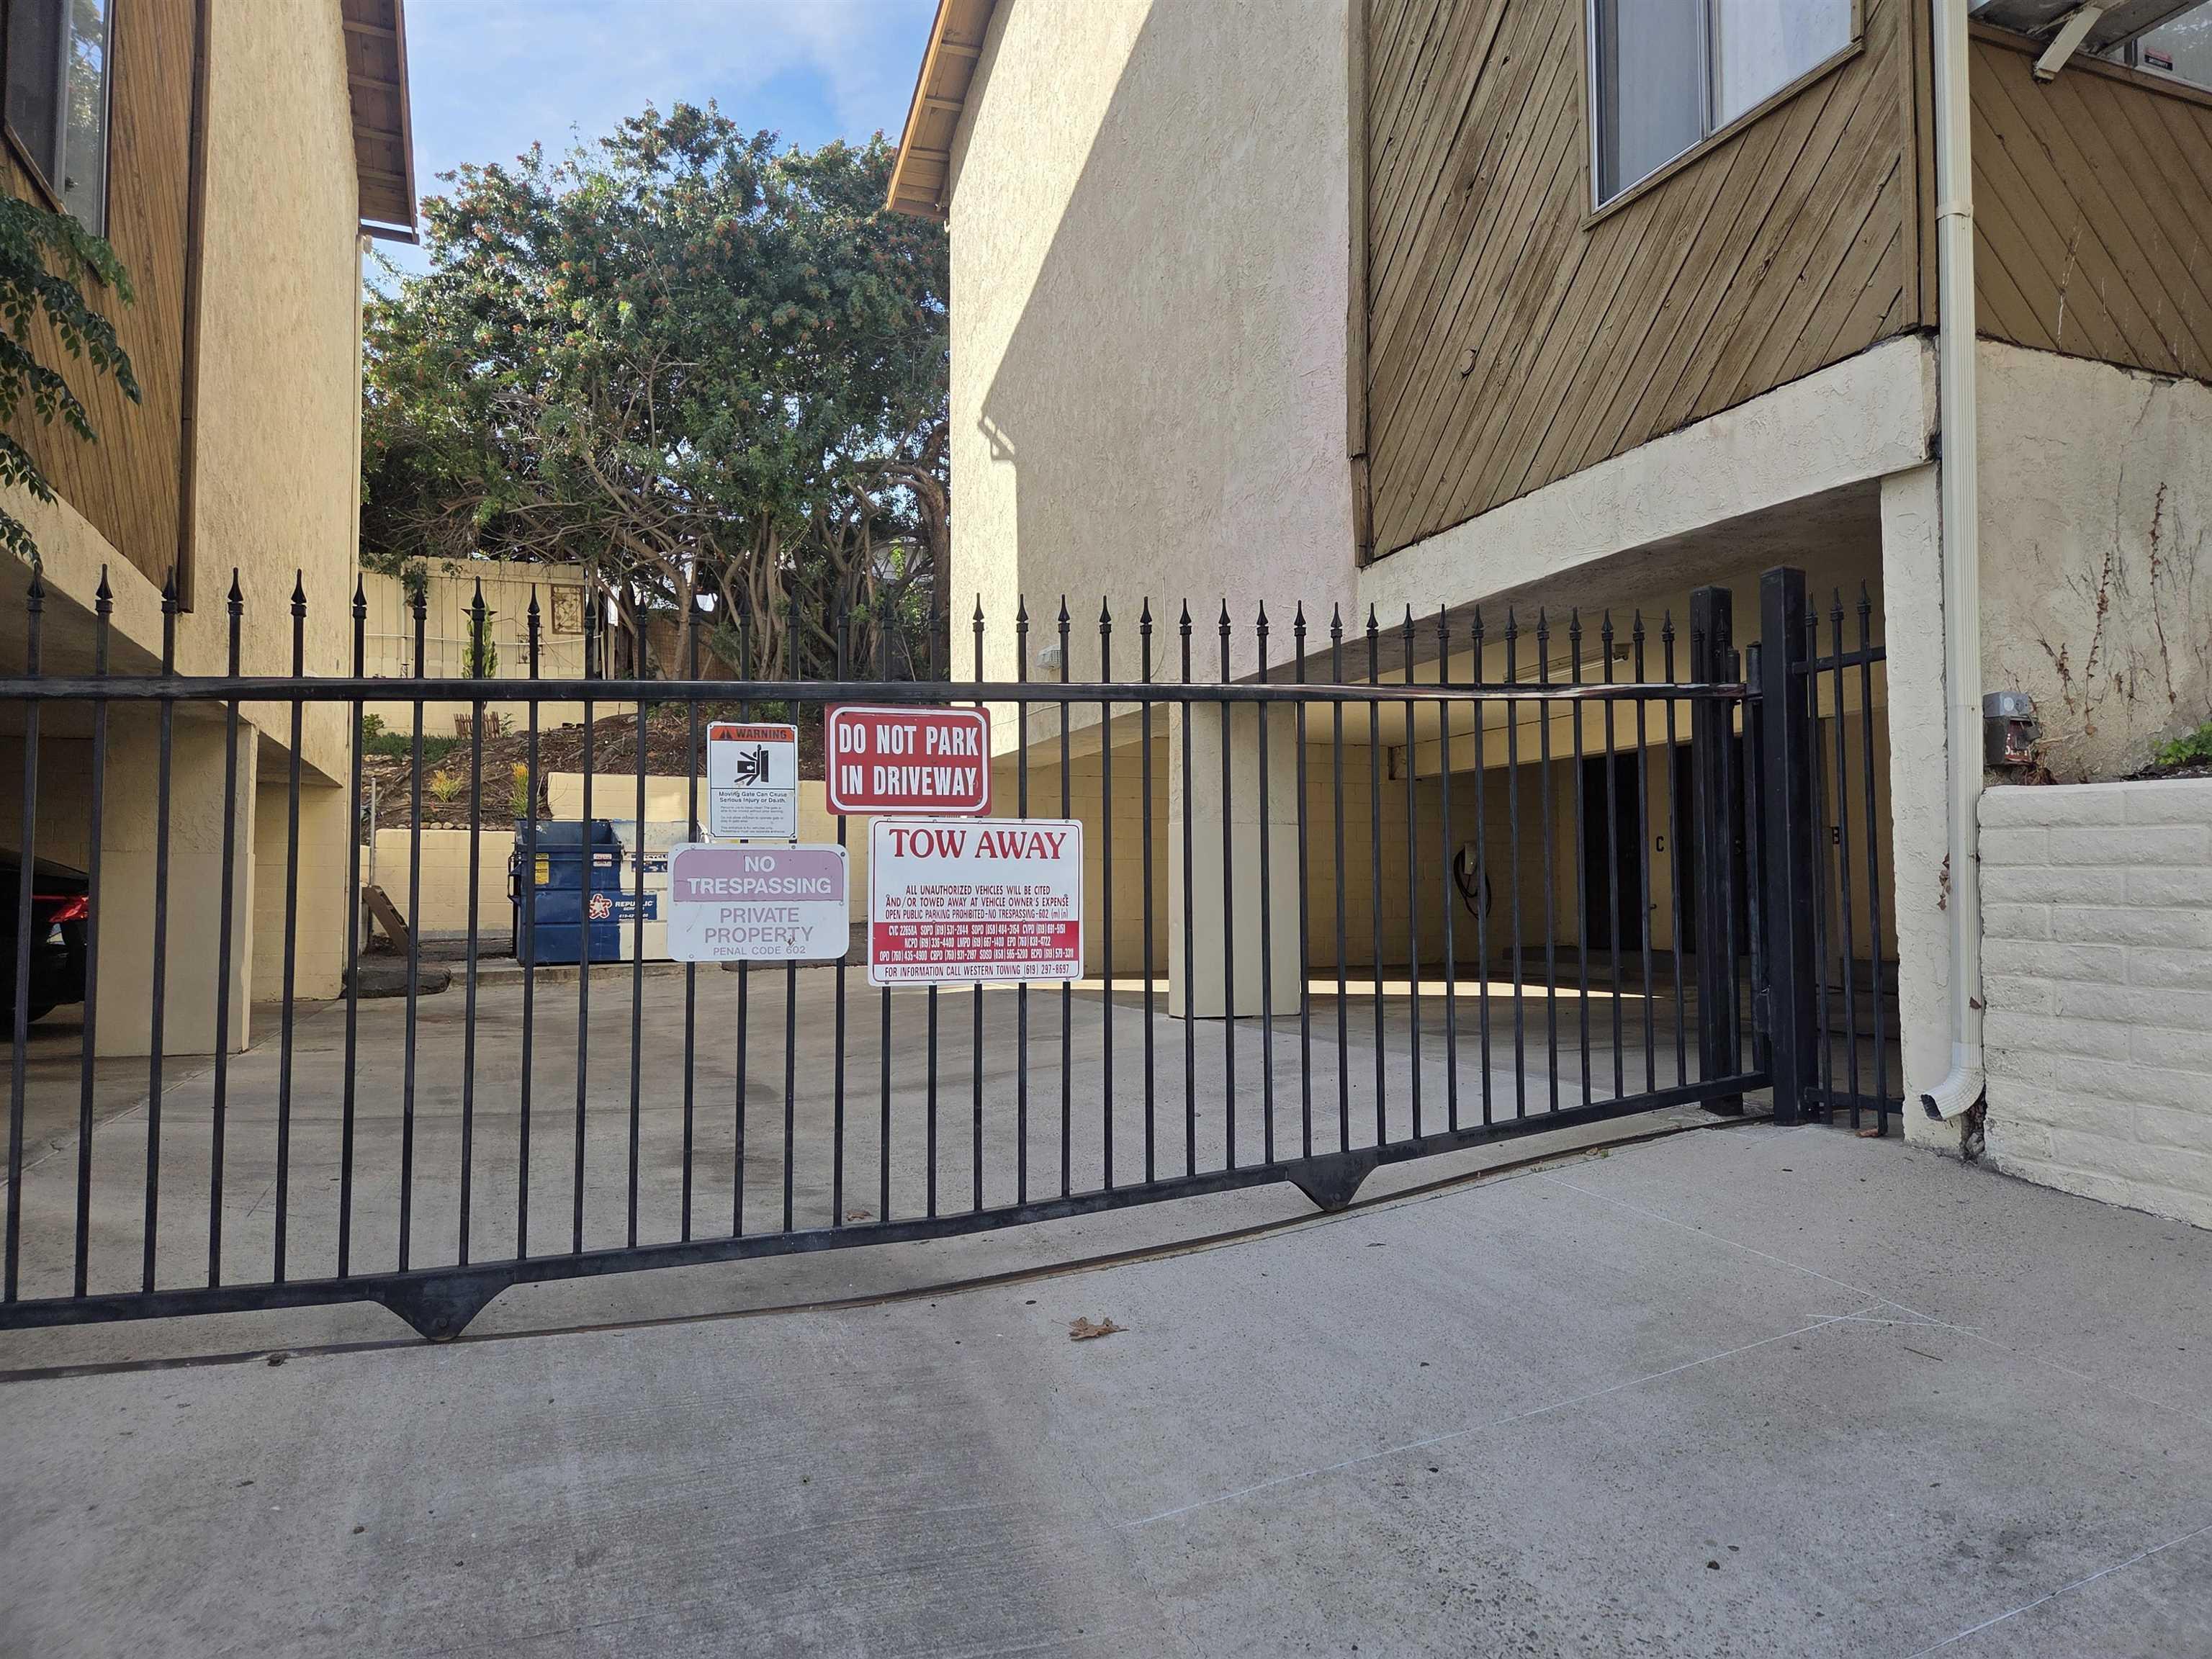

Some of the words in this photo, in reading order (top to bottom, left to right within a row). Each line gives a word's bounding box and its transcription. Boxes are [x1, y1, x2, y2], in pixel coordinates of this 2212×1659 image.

[736, 729, 787, 739] WARNING
[839, 724, 866, 754] DO
[876, 724, 917, 755] NOT
[926, 726, 979, 756] PARK
[842, 765, 863, 795] IN
[873, 766, 977, 796] DRIVEWAY
[889, 829, 967, 858] TOW
[974, 830, 1067, 859] AWAY
[744, 855, 775, 873] NO
[688, 878, 832, 894] TRESPASSING
[906, 885, 917, 895] ALL
[920, 885, 972, 895] UNAUTHORIZED
[975, 885, 1003, 895] VEHICLES
[1006, 885, 1021, 895] WILL
[1024, 885, 1031, 895] BE
[1034, 886, 1051, 895] CITED
[886, 897, 917, 907] AND/OR
[920, 897, 945, 907] TOWED
[948, 897, 966, 907] AWAY
[970, 897, 978, 907] AT
[981, 897, 1006, 907] VEHICLE
[1008, 897, 1039, 907] OWNER'S
[1042, 897, 1069, 907] EXPENSE
[720, 907, 799, 923] PRIVATE
[886, 909, 900, 920] OPEN
[903, 909, 922, 920] PUBLIC
[925, 909, 950, 919] PARKING
[705, 926, 814, 943] PROPERTY
[713, 947, 747, 956] PENAL
[751, 946, 781, 955] CODE
[786, 945, 806, 954] 602
[885, 967, 897, 977] FOR
[900, 966, 943, 976] INFORMATION
[946, 966, 961, 976] CALL
[964, 966, 994, 976] WESTERN
[997, 965, 1020, 975] TOWING
[1023, 964, 1038, 975] (619)
[1041, 964, 1069, 974] 297-8697
